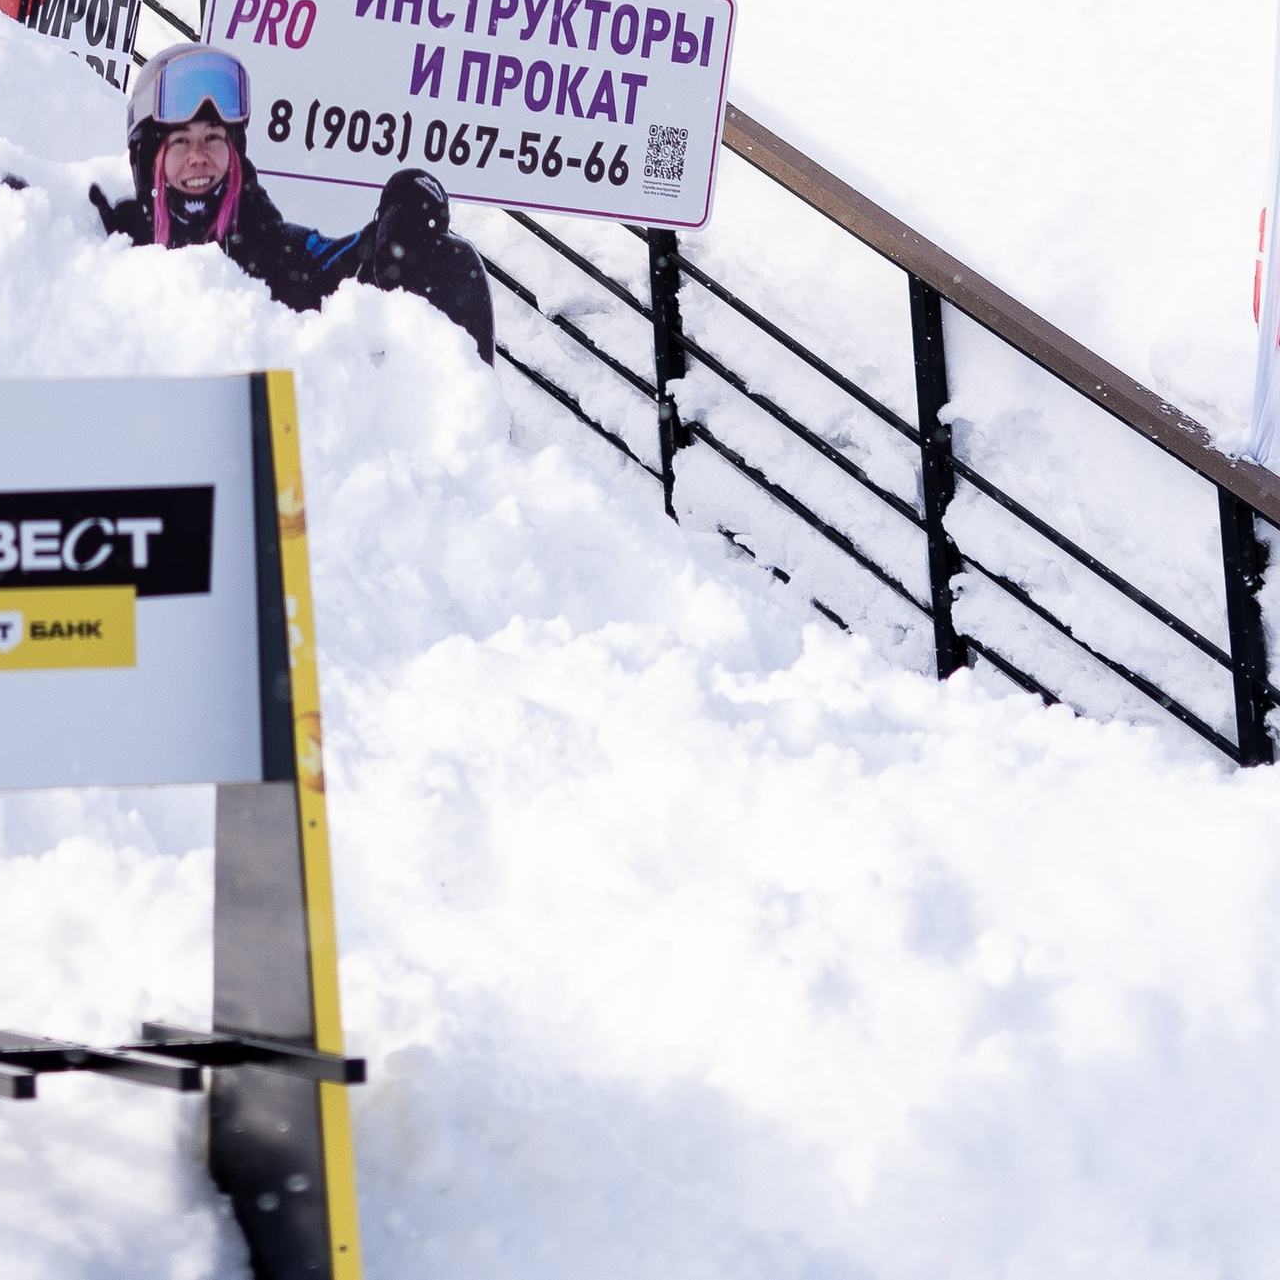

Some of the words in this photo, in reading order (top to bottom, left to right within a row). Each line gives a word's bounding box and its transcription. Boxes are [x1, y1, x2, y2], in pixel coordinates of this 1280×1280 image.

[409, 42, 446, 99] И
[456, 50, 648, 125] ПРОКАТ
[267, 99, 293, 143] 8
[304, 98, 412, 163] (903)
[424, 120, 630, 186] 067-56-66
[30, 619, 104, 641] БАНК
